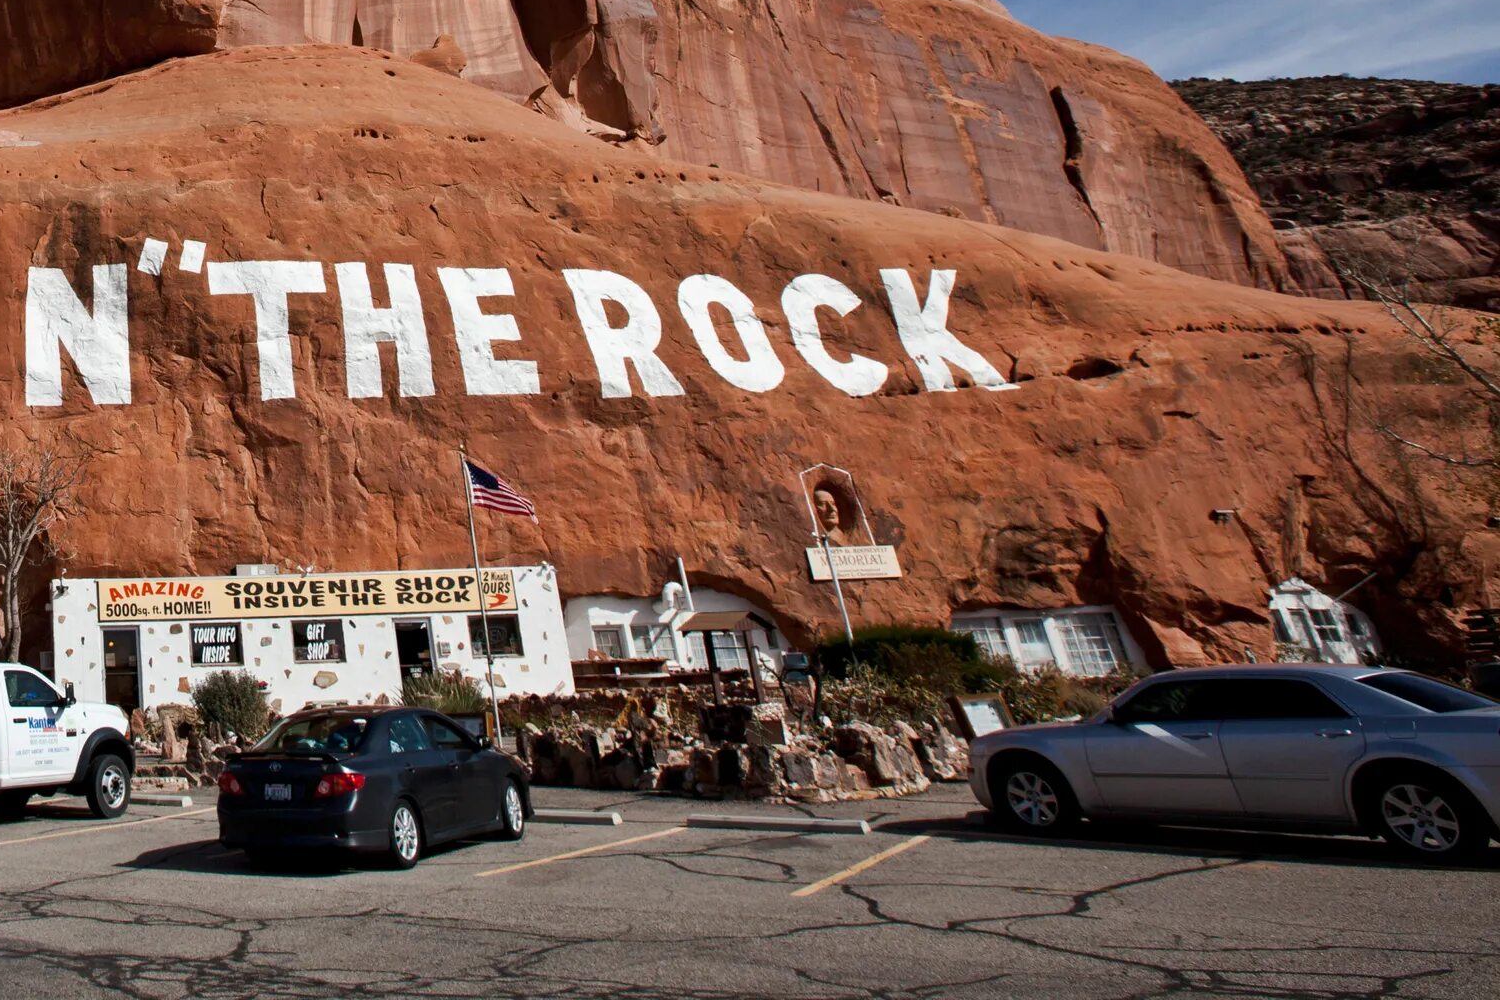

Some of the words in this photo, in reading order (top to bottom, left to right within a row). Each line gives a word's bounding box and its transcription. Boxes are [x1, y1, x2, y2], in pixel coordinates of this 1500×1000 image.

[207, 260, 541, 401] THE
[562, 267, 1022, 399] ROCK
[109, 582, 204, 602] AMAZING
[225, 579, 382, 595] SOUVENIR
[395, 576, 475, 591] SHOP
[233, 595, 326, 609] INSIDE
[336, 593, 386, 606] THE
[397, 590, 471, 604] ROCK
[106, 604, 137, 617] 5000
[152, 605, 162, 614] ft.
[164, 601, 212, 615] HOME!!
[193, 627, 217, 643] TOUR
[217, 627, 236, 643] INFO
[306, 623, 325, 640] GIFT
[202, 646, 230, 663] INSIDE
[306, 642, 329, 660] SHOP
